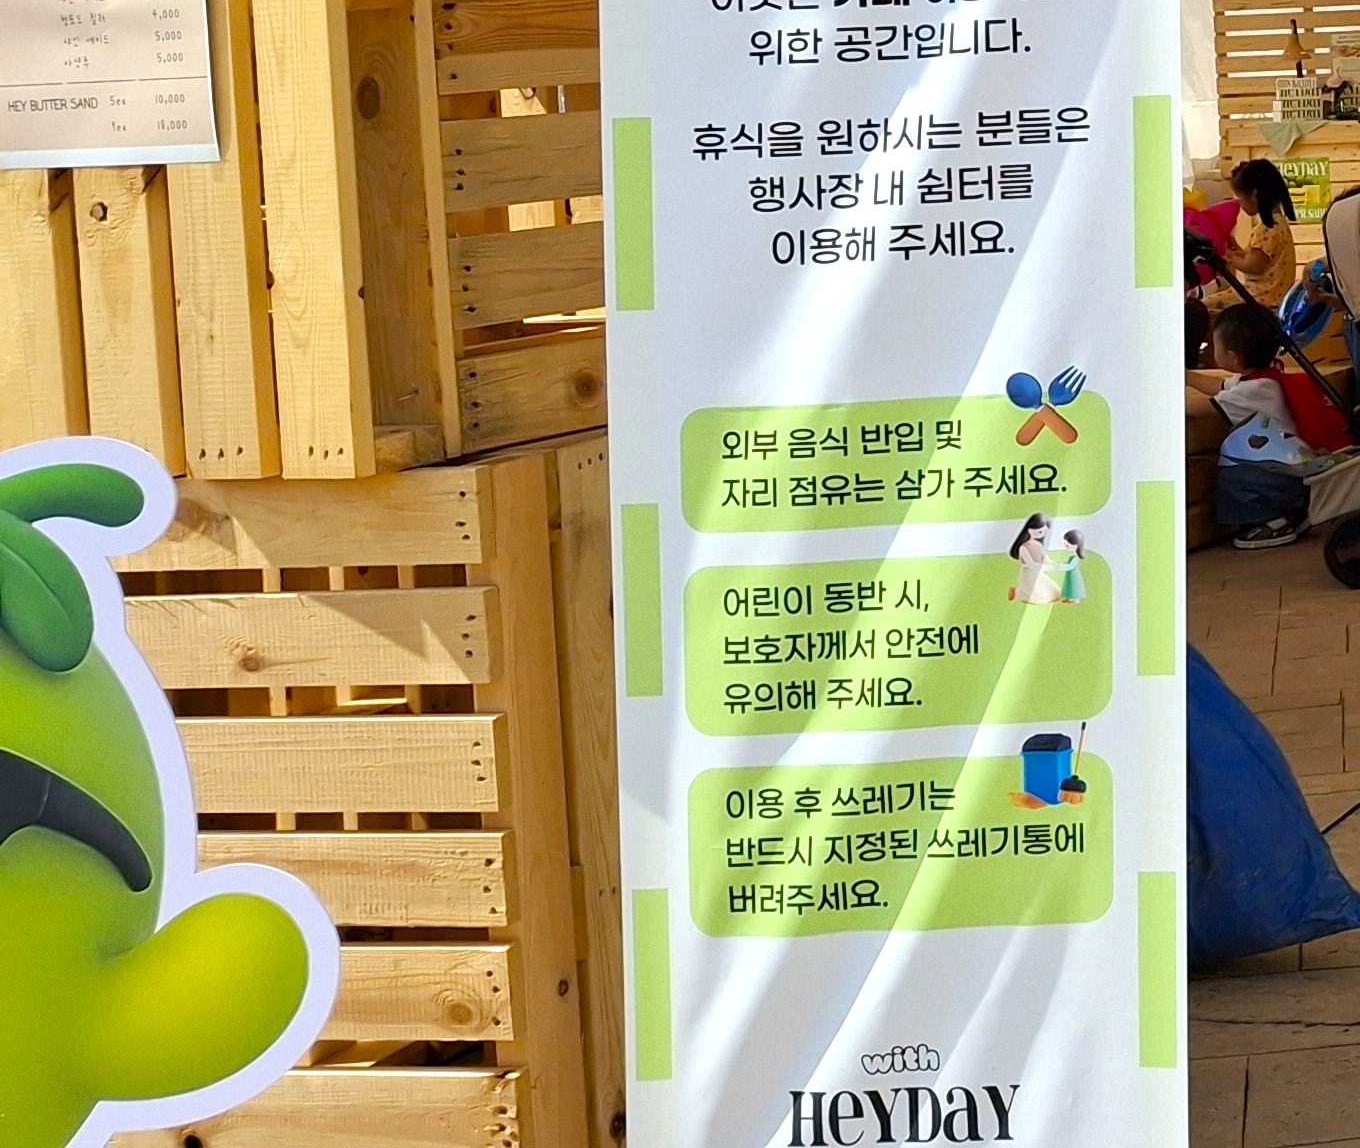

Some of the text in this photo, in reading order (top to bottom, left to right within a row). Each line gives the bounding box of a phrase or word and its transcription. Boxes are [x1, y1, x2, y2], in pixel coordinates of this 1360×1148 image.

[152, 8, 180, 20] 4,000
[154, 30, 182, 42] 5,000
[748, 17, 1032, 66] 위한 공간입니다.
[156, 52, 184, 64] 5,000
[8, 100, 26, 112] HEY
[30, 98, 68, 112] BUTTER
[70, 97, 99, 110] SAND
[155, 93, 186, 106] 10,000
[157, 119, 188, 132] 18,000
[691, 106, 1091, 161] 휴식을 원하시는 분들은
[748, 162, 1035, 213] 행사장 내 쉼터를
[771, 219, 1016, 266] 이용해 주세요.
[720, 419, 964, 463] 외부 음식 반입 및
[720, 463, 1068, 511] 자리 점유는 삼가 주세요.
[722, 578, 930, 619] 어린이 동반 시,
[721, 623, 980, 668] 보호자께서 안전에
[722, 676, 923, 715] 유의해 주세요.
[724, 779, 956, 820] 이용 후 쓰레기는
[724, 822, 1086, 870] 반드시 지정된 쓰레기통에
[727, 880, 889, 916] 버려주세요.
[861, 1042, 941, 1075] with
